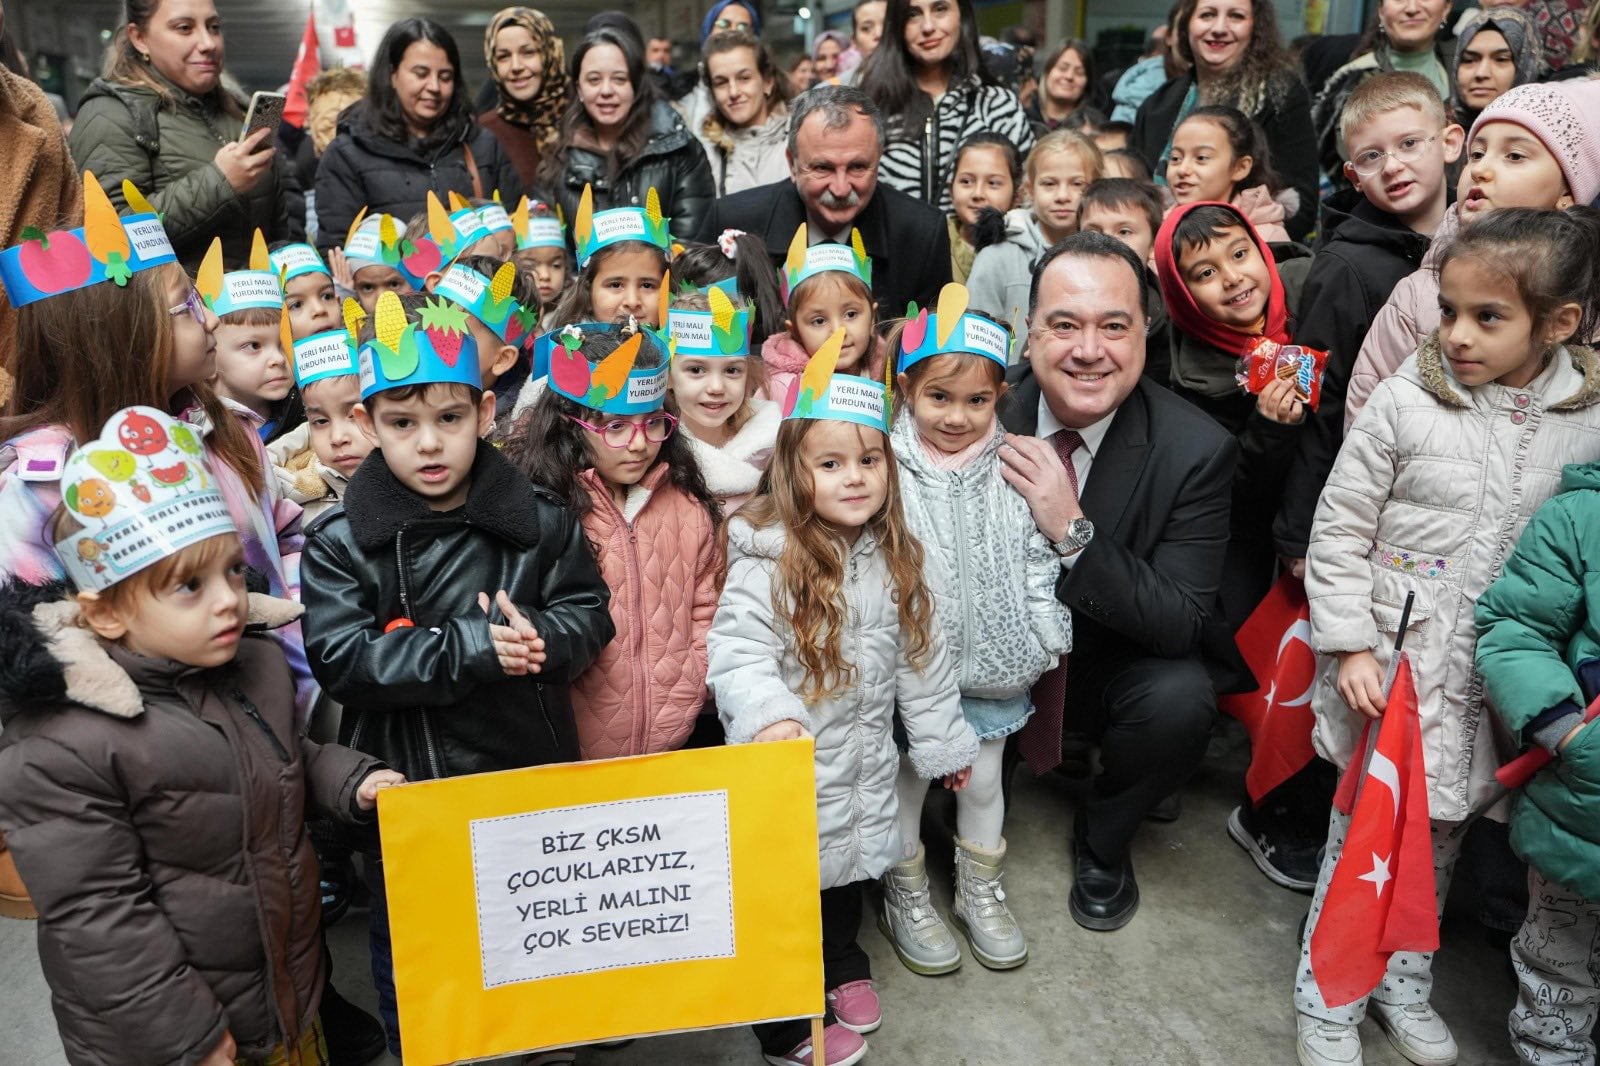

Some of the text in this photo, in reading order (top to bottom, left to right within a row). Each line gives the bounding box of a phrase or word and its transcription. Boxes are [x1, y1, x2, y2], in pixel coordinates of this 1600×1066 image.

[686, 322, 703, 330] MALI
[691, 333, 710, 341] MALI
[319, 343, 340, 353] MALI
[327, 353, 349, 362] MALI
[836, 385, 879, 400] YERLİ MALI
[830, 396, 883, 414] YURDUN MALI
[542, 823, 661, 854] BİZ ÇKSM
[507, 851, 695, 894] ÇOCUKLARIYIZ,
[516, 884, 691, 922] YERLİ MALINI
[523, 913, 689, 955] ÇOK SEVERİZ!
